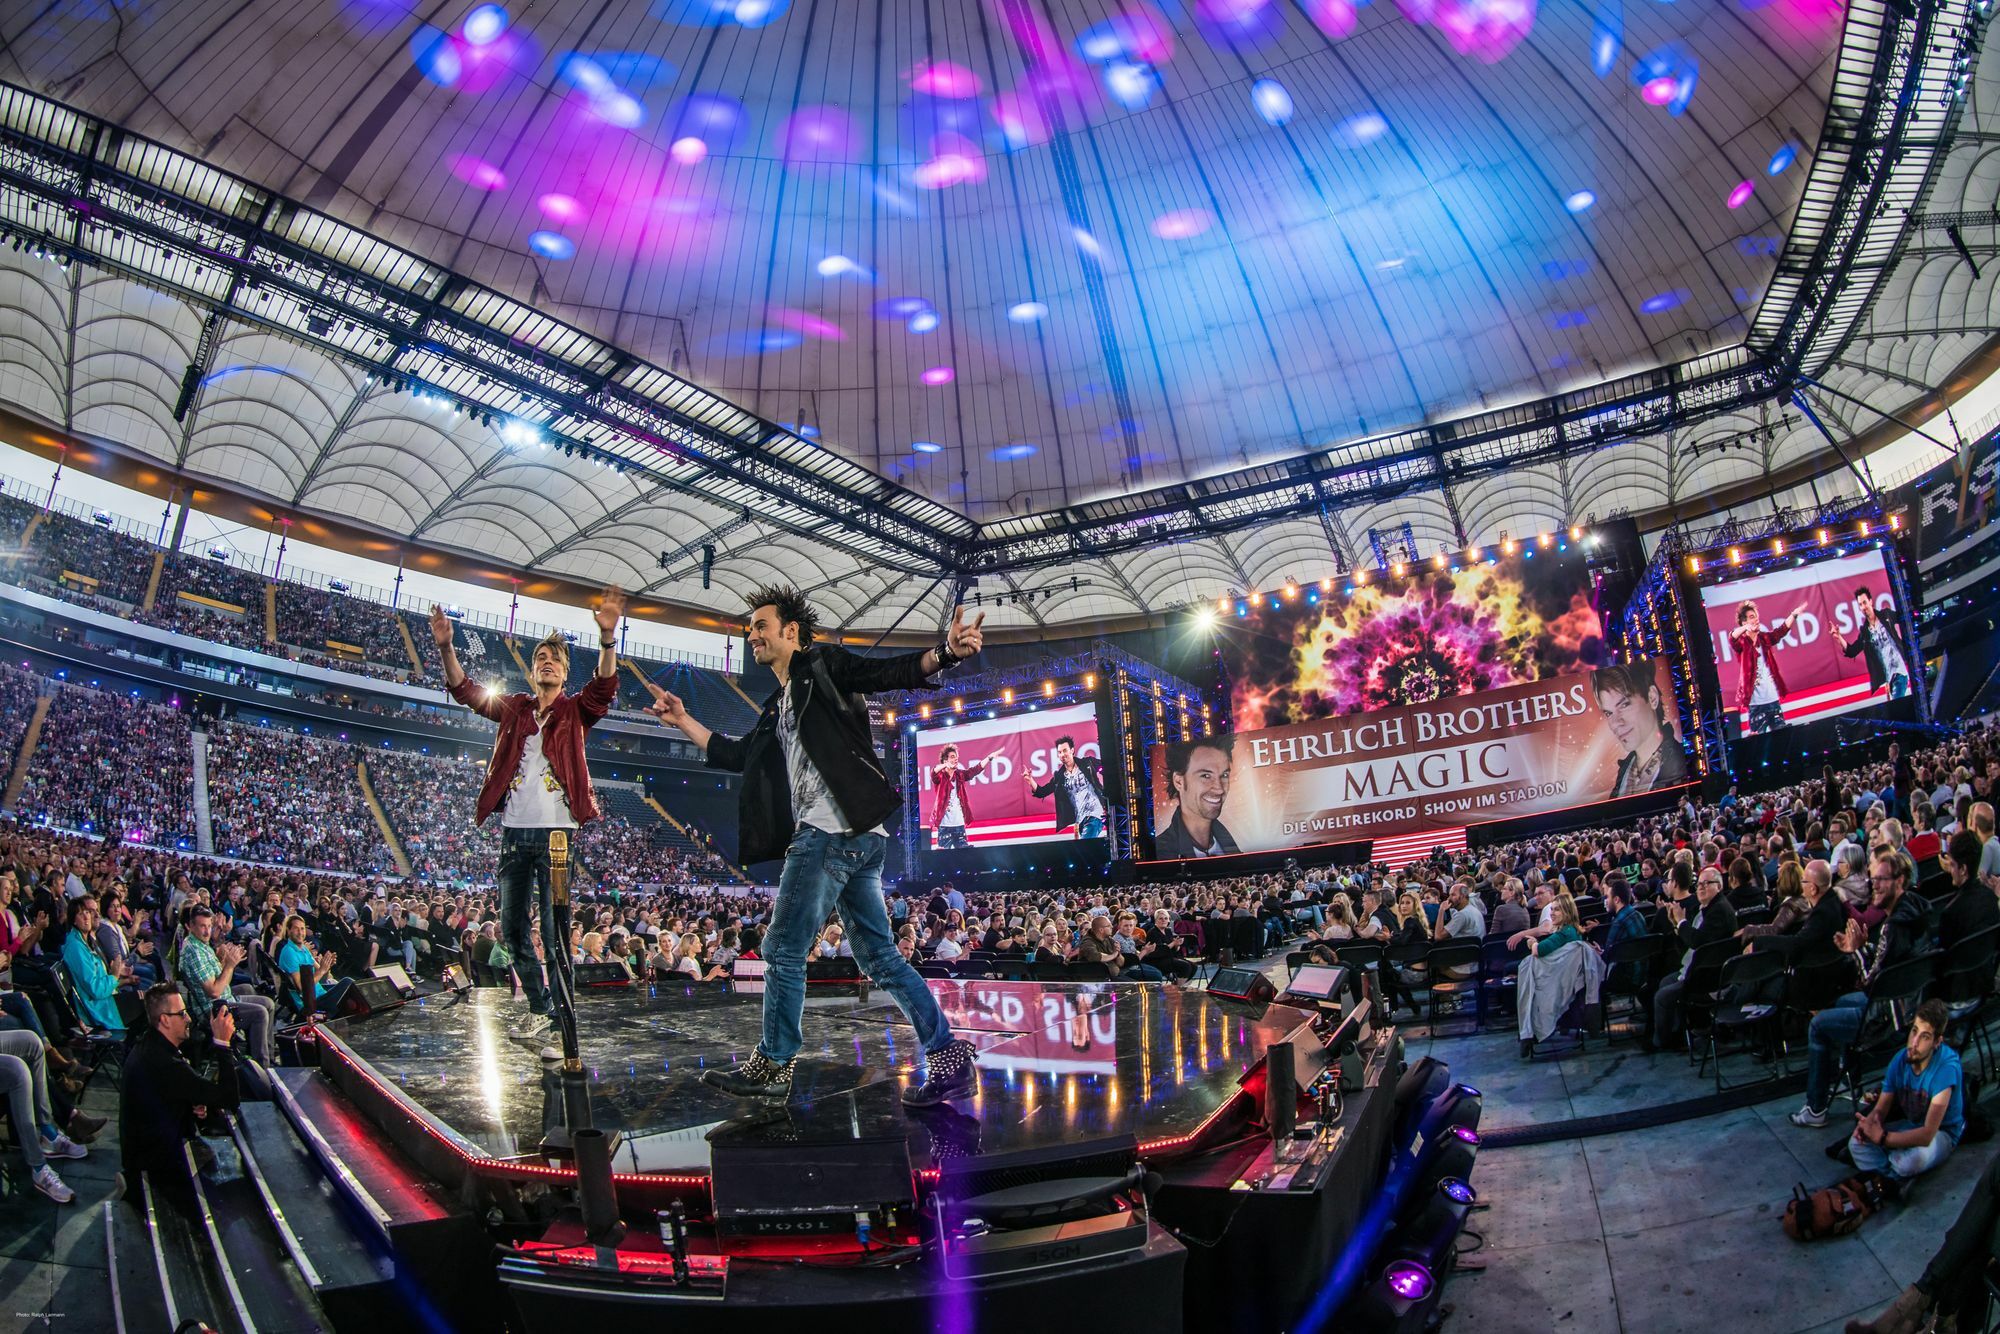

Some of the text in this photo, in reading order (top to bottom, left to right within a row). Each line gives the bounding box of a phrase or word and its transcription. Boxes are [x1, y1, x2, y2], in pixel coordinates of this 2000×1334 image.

[1249, 684, 1587, 768] EHRLICH BROTHERS
[1341, 743, 1510, 802] MAGIC
[1283, 780, 1568, 835] DIE WELTREKORD SHOW IM STADION
